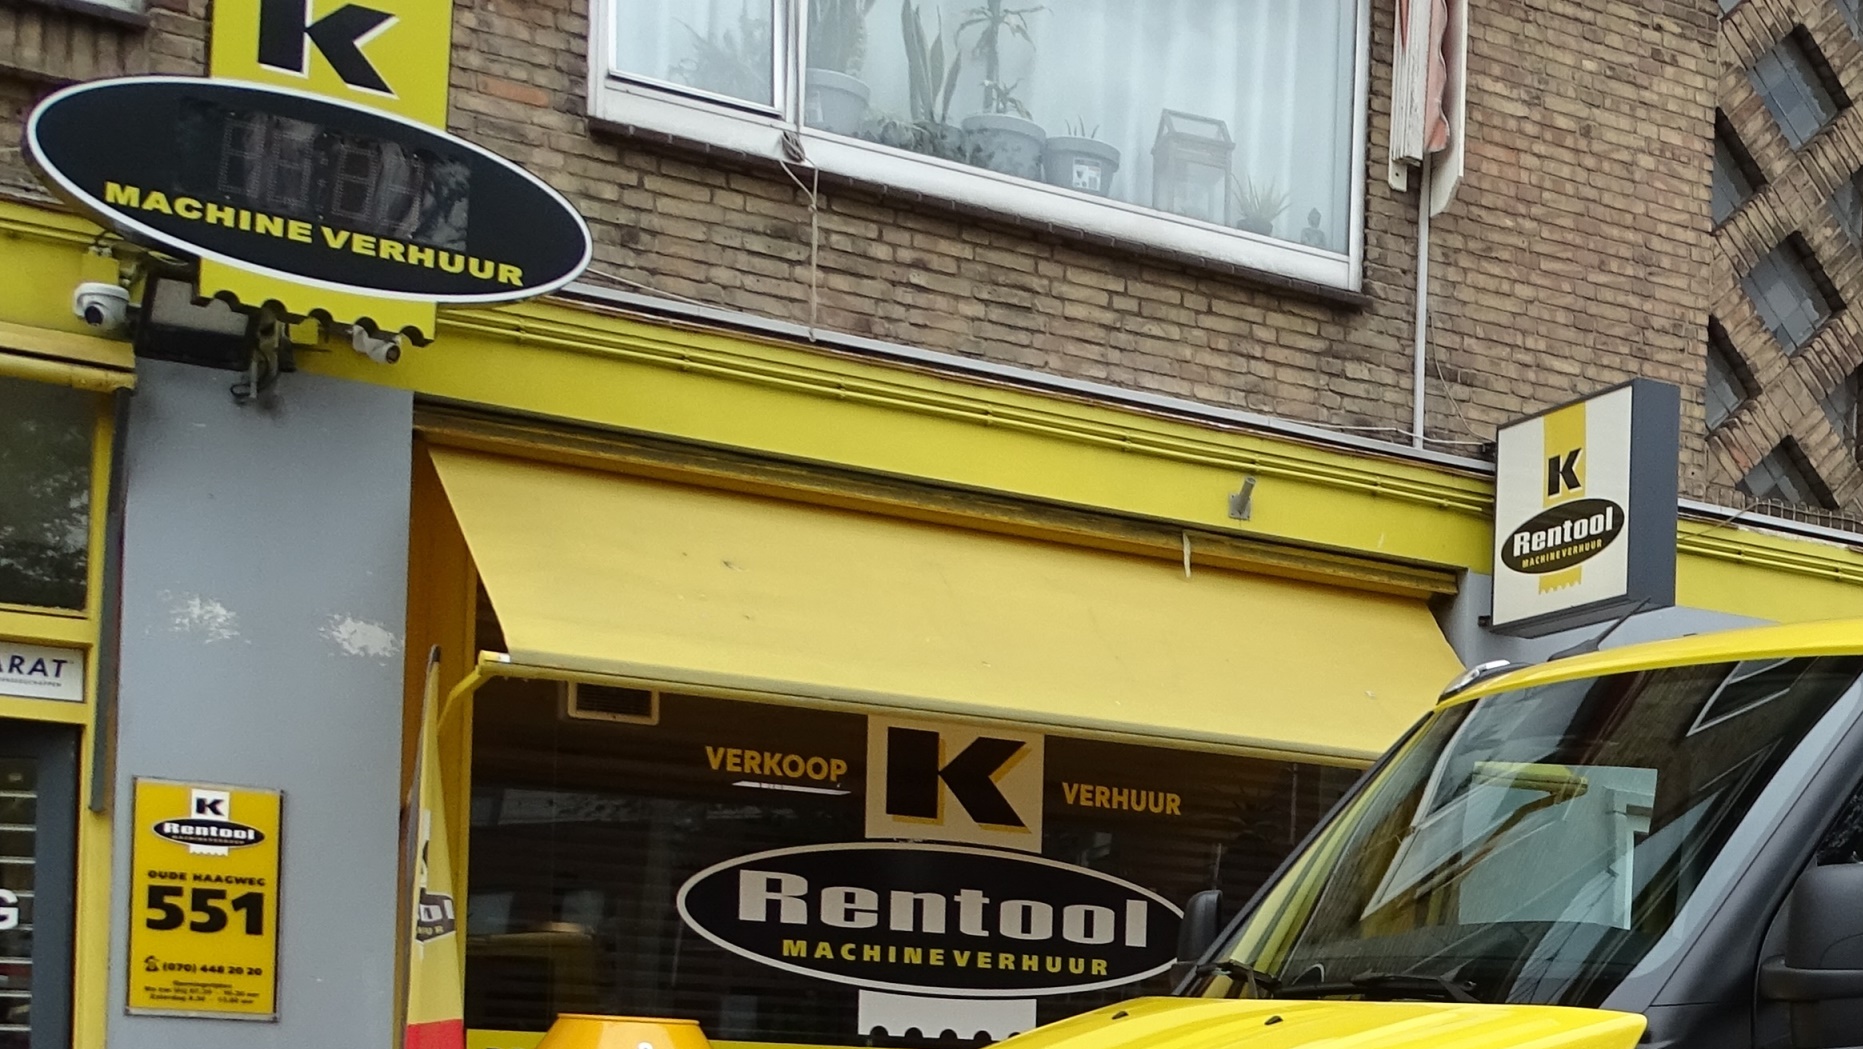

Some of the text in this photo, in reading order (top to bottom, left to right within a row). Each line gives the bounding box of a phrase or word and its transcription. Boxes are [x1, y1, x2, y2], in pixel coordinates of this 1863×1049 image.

[103, 181, 525, 287] MACHINE VERHUUR
[1547, 447, 1582, 497] K
[1512, 506, 1614, 557] Rentool
[0, 654, 68, 678] RAT
[705, 745, 848, 782] VERKOOP
[886, 726, 1032, 834] K
[196, 797, 226, 817] K
[1062, 781, 1182, 816] VERHUUR
[163, 822, 256, 841] Rentool
[147, 869, 266, 887] OUDE HAAGWEG
[145, 884, 264, 936] 551
[738, 868, 1148, 948] Rentool
[162, 962, 263, 976] (070) 448 20 20
[782, 938, 1109, 976] MACHINEVERHUUR
